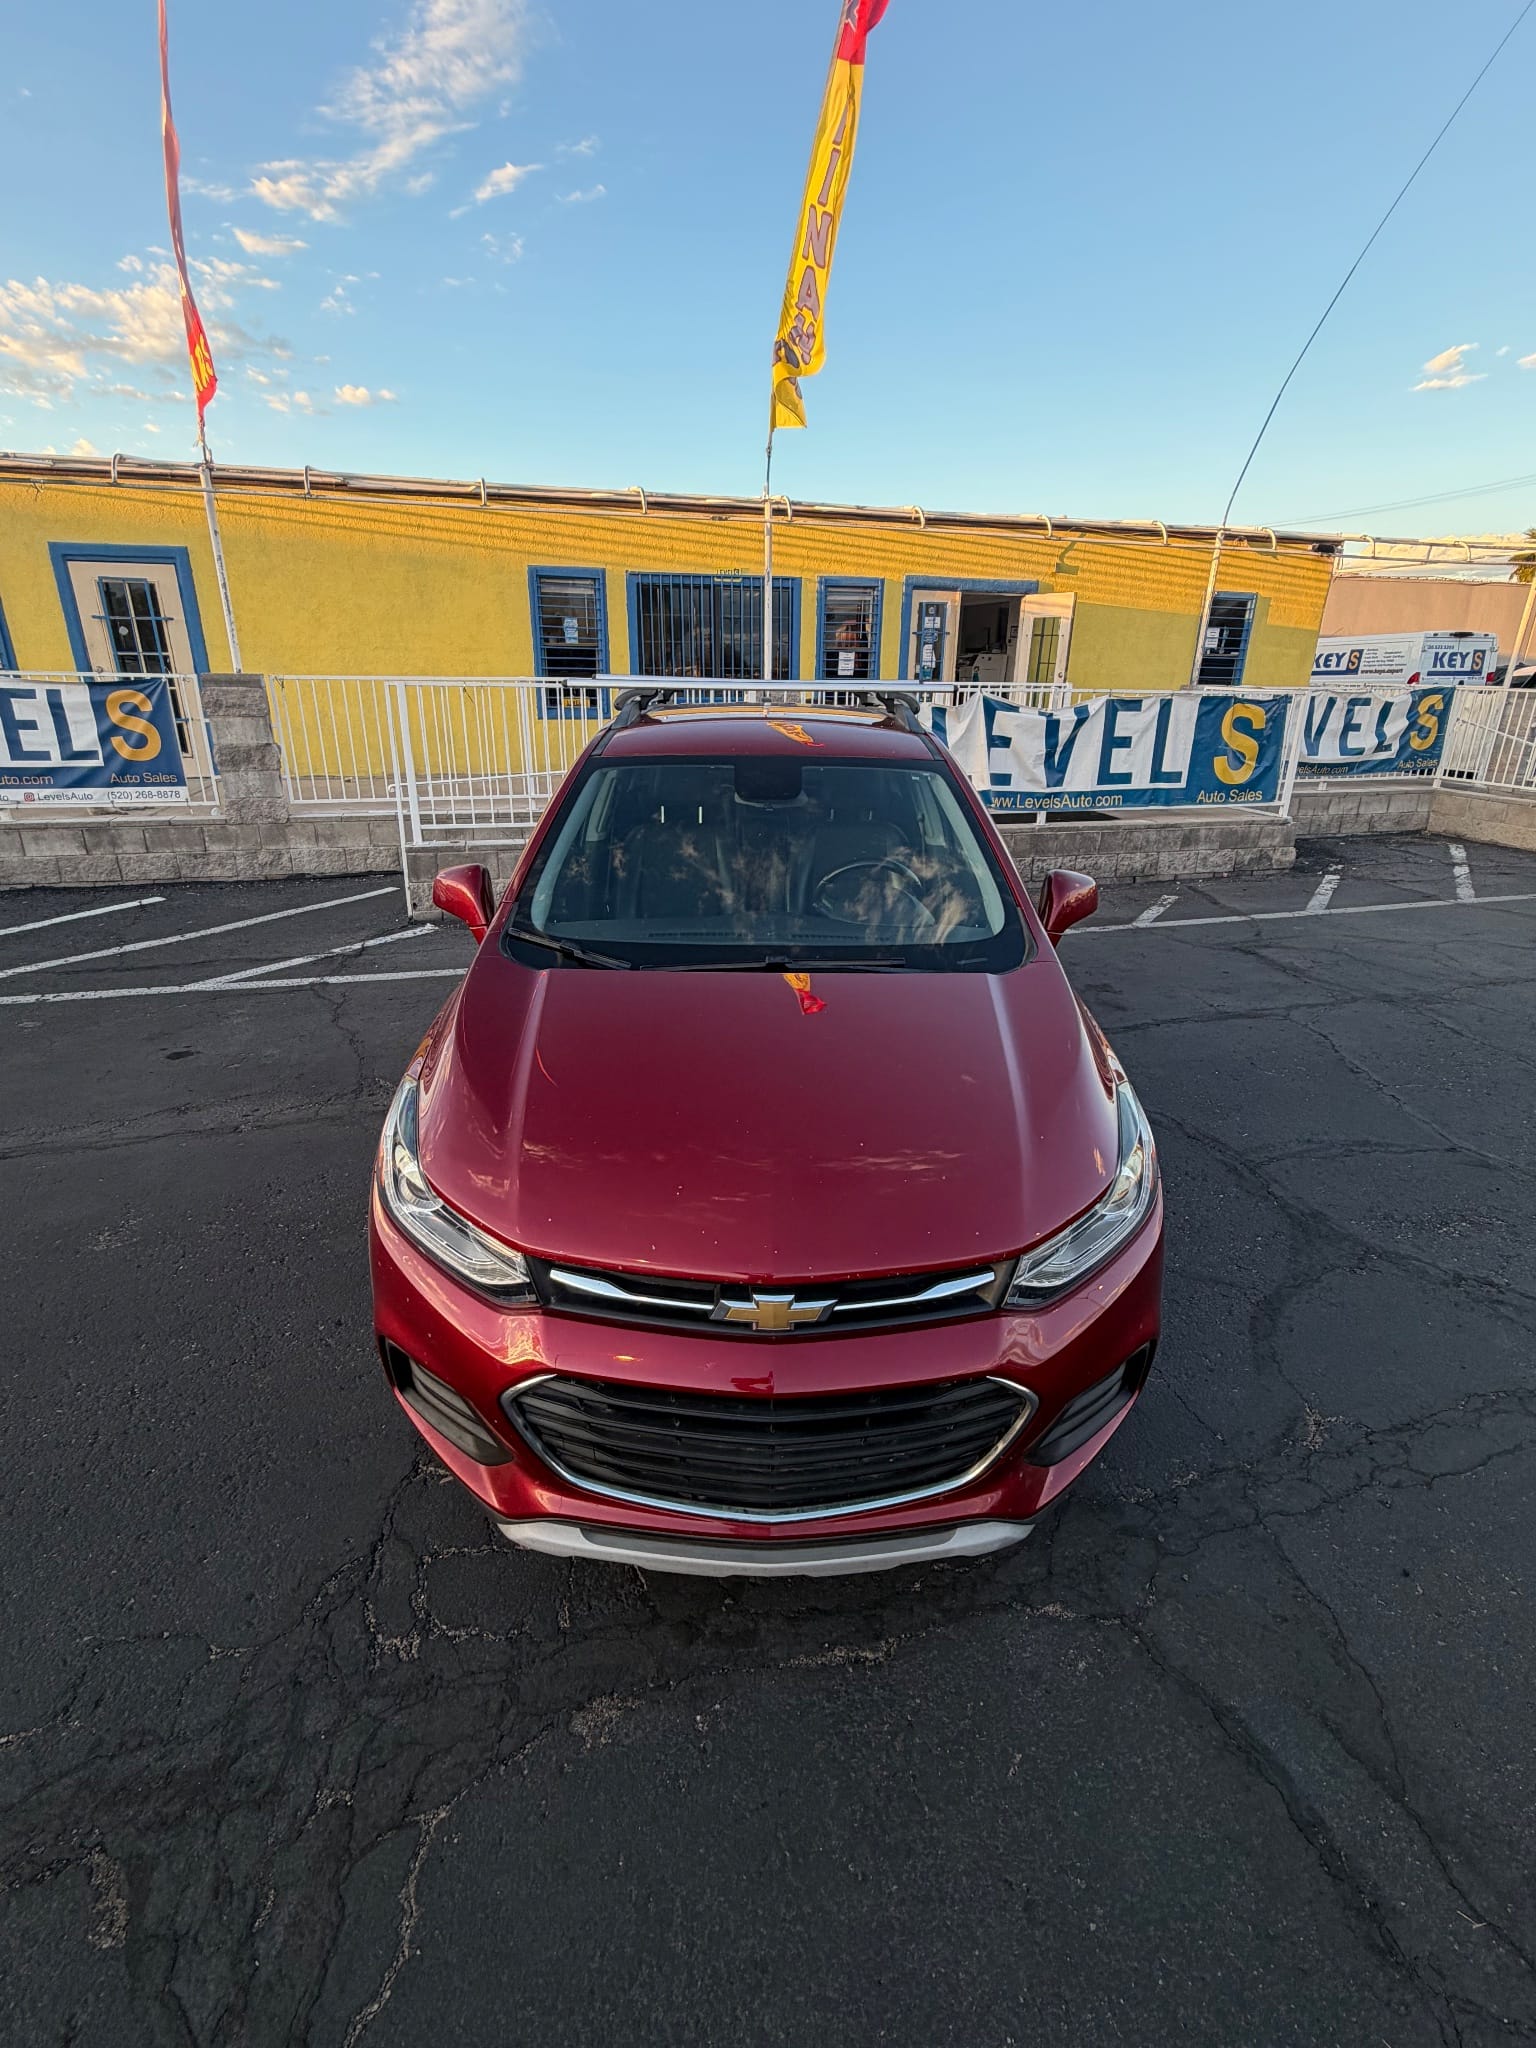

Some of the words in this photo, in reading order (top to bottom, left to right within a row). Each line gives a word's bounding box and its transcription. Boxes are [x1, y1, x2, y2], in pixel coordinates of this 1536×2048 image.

[1297, 765, 1349, 775] elsAuto.com
[110, 772, 140, 784] Auto
[143, 772, 178, 783] Sales
[37, 792, 94, 802] LevelsAuto
[107, 790, 133, 801] (520)
[135, 790, 181, 800] 268-8878
[1197, 788, 1225, 804] Auto
[1229, 788, 1263, 803] Sales
